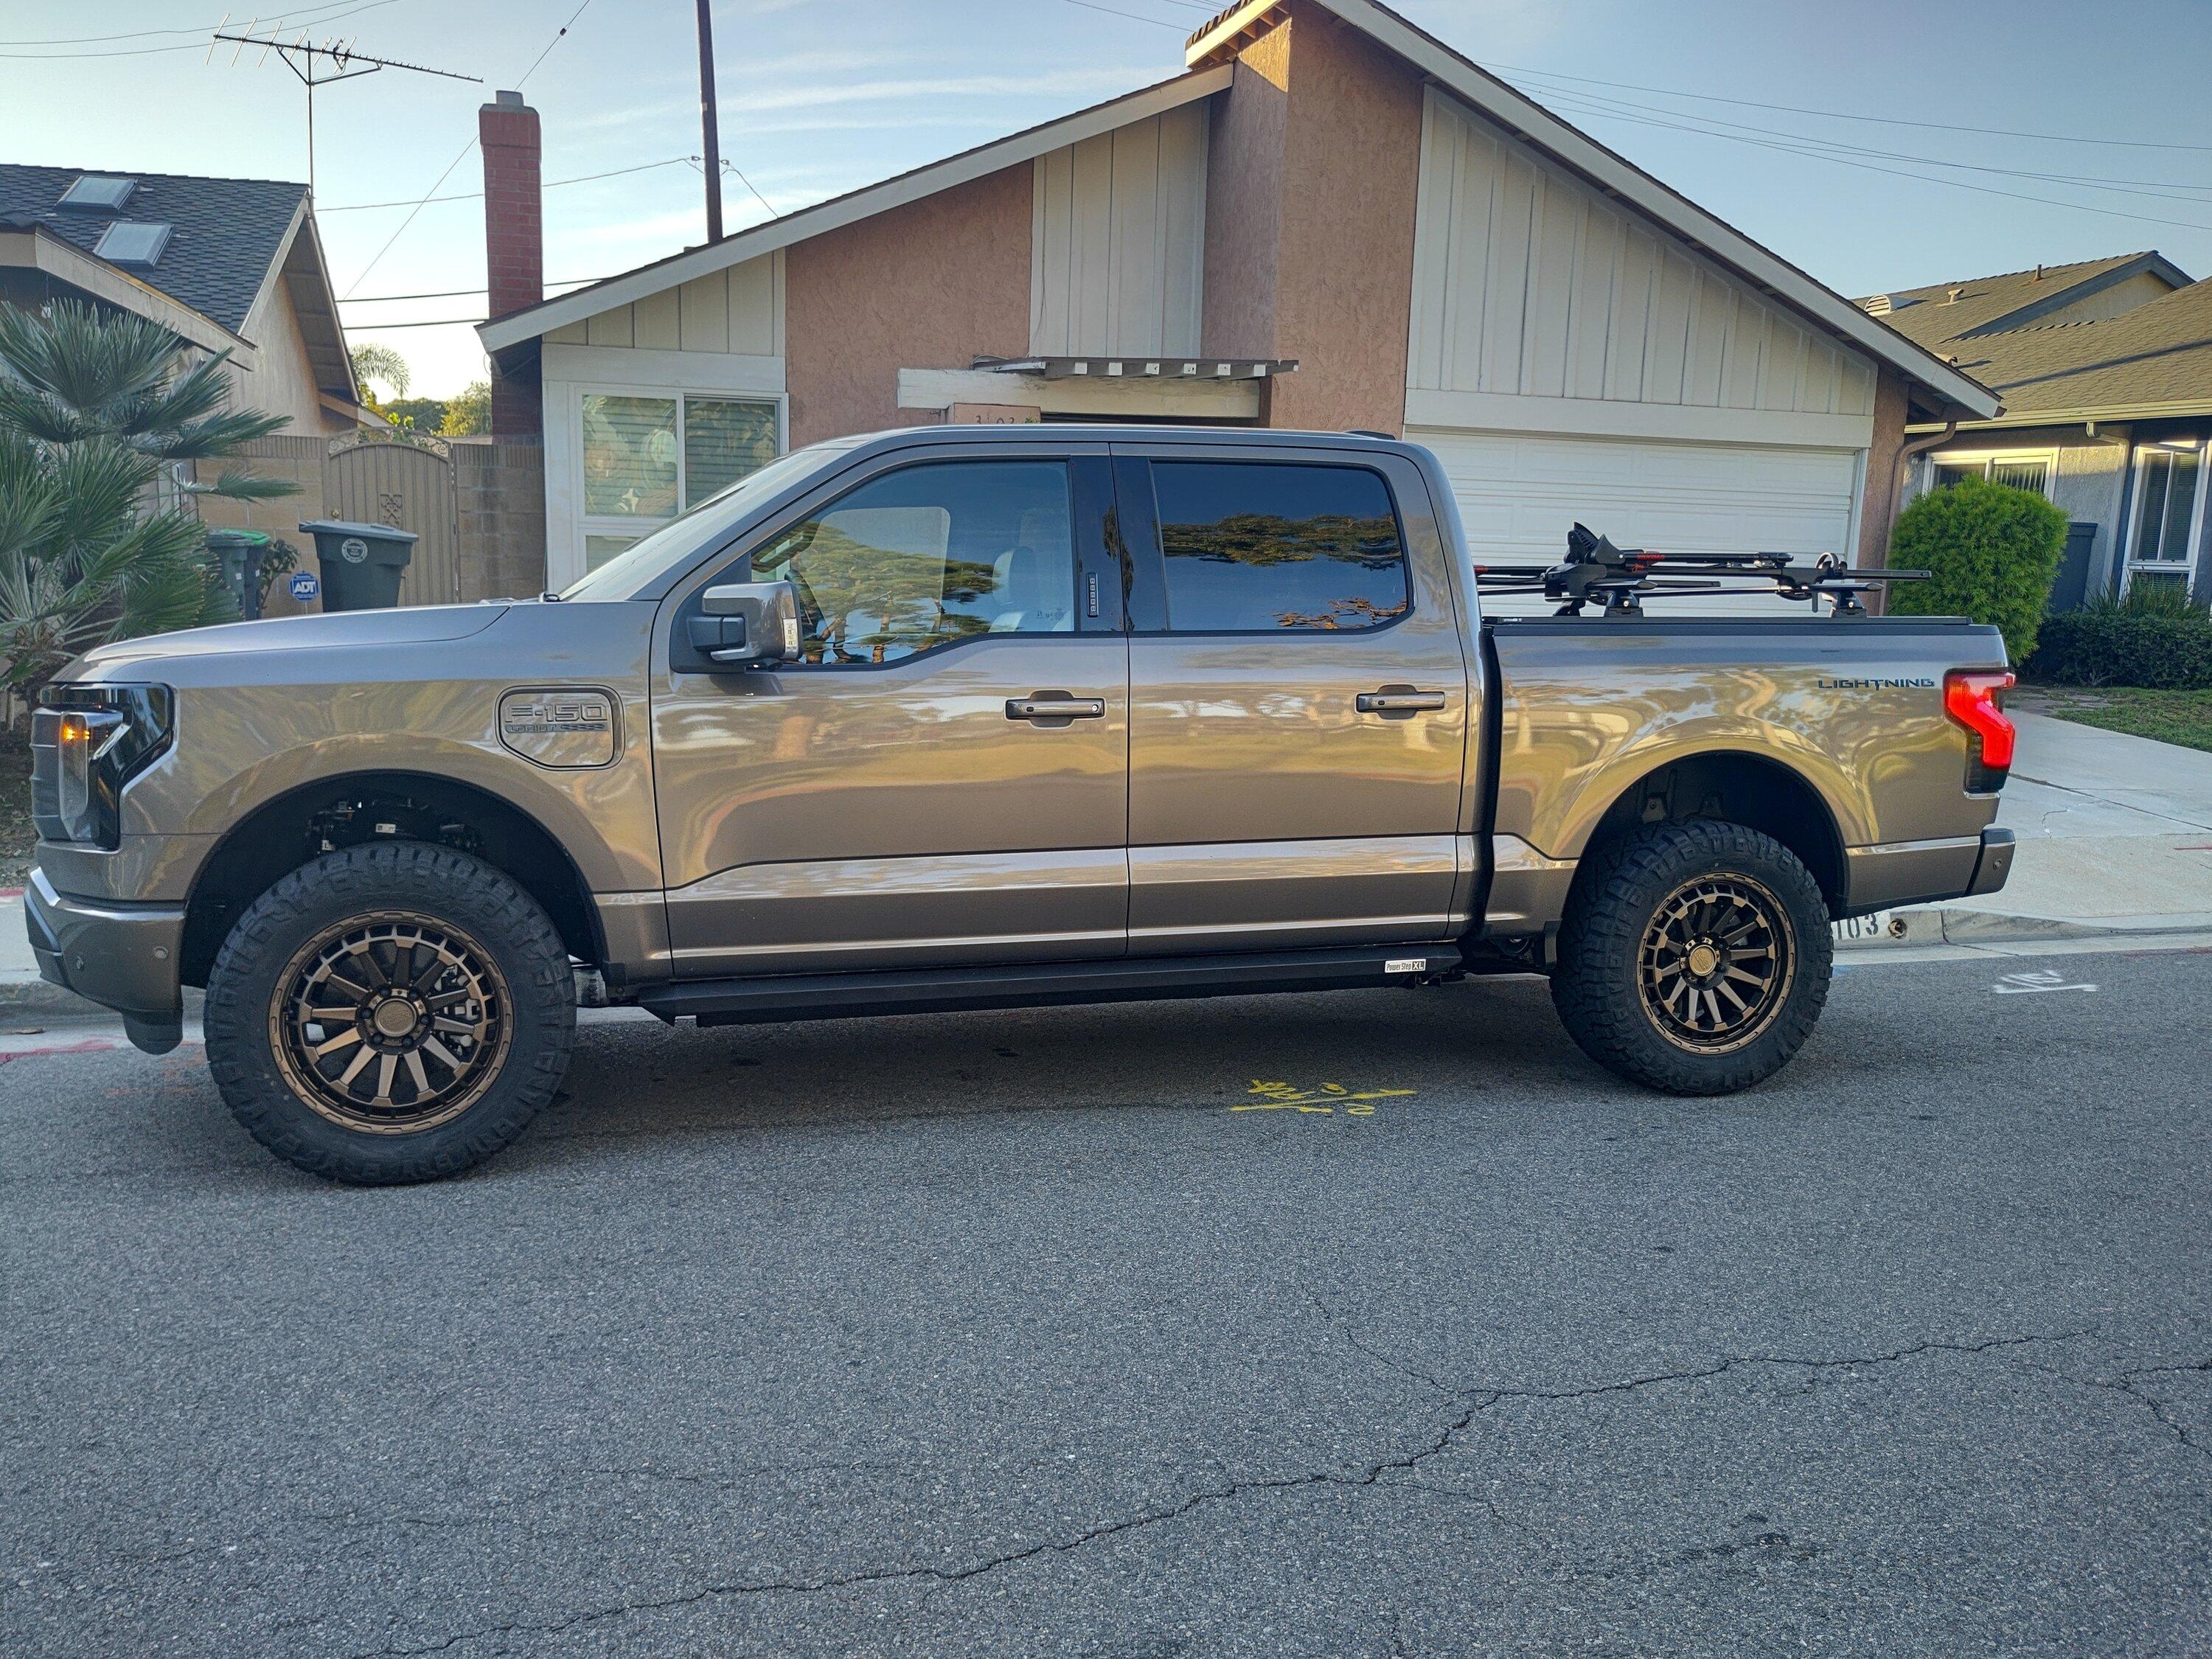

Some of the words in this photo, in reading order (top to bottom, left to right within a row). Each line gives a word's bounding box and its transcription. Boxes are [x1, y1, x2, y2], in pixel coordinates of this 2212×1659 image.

[293, 581, 316, 593] ADT
[1818, 678, 1935, 691] LIGHTNING
[504, 703, 608, 723] F-150
[1413, 961, 1424, 970] XL
